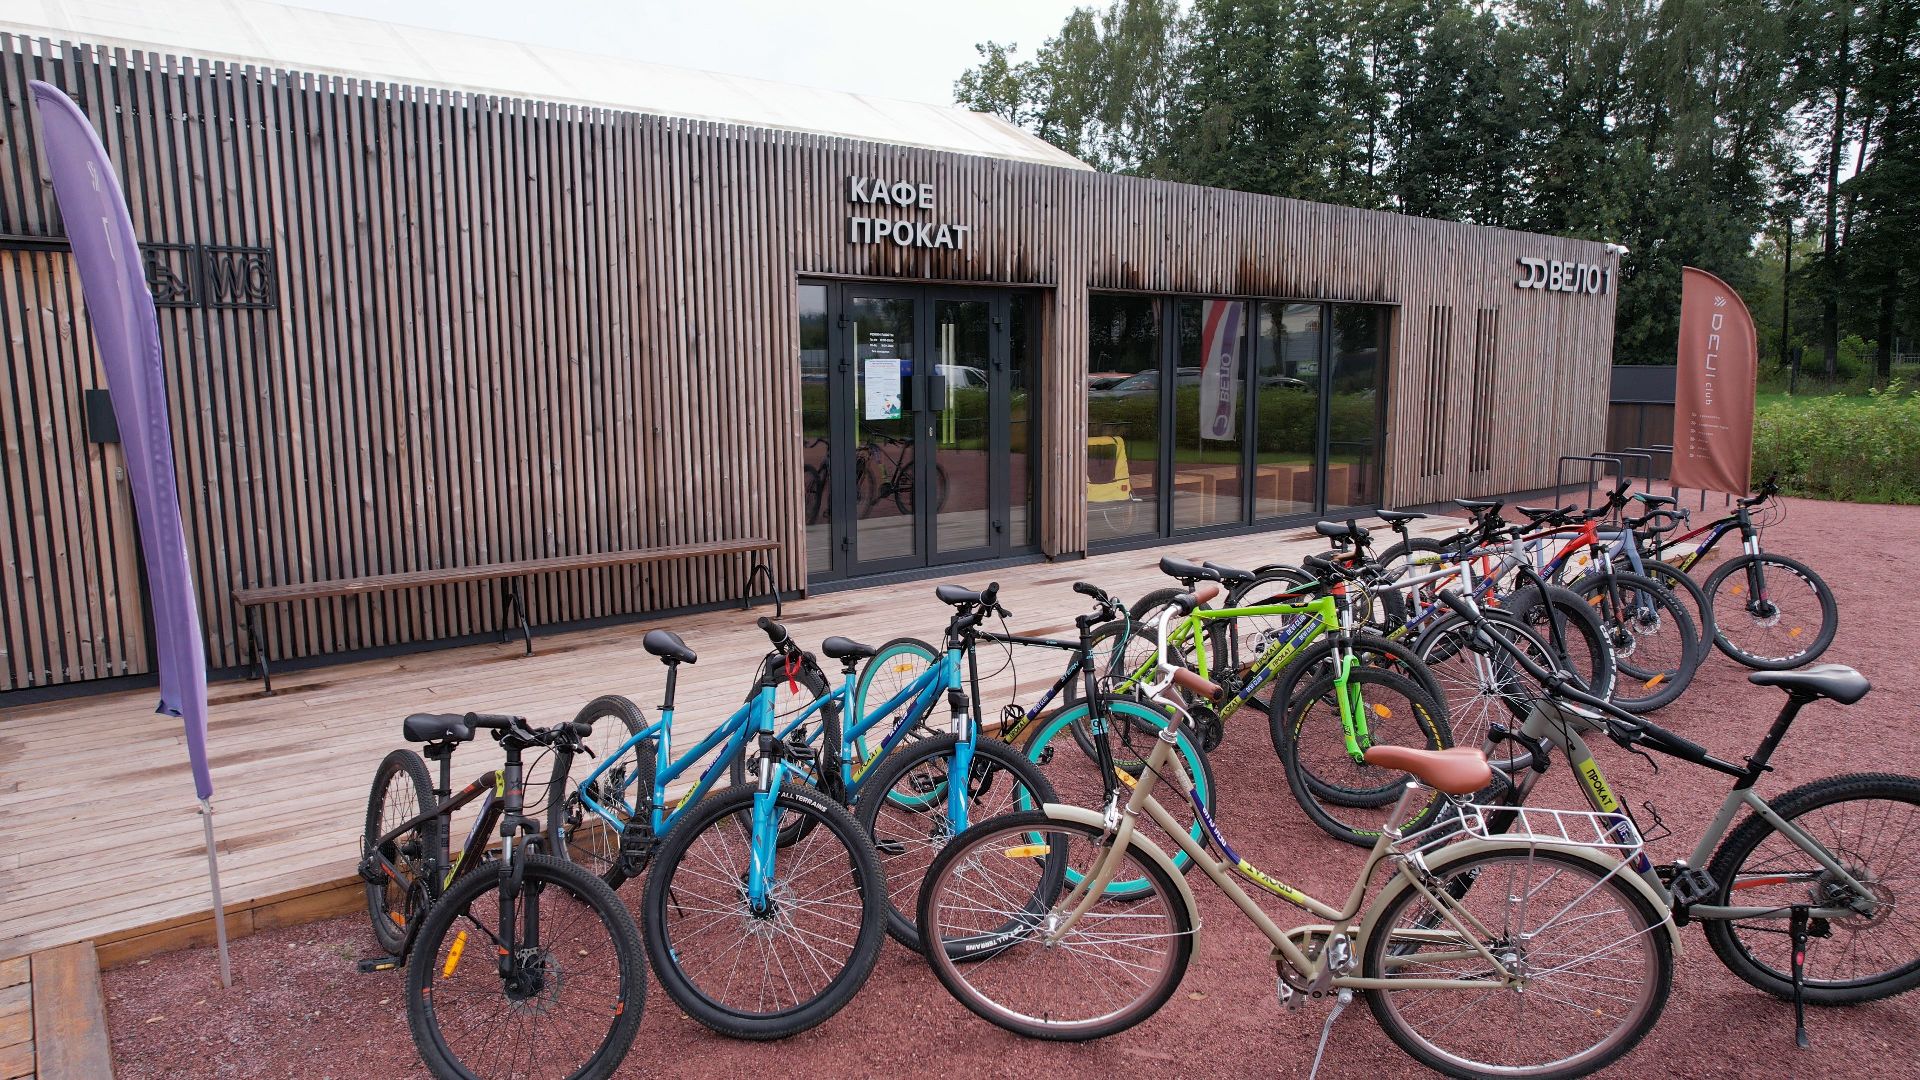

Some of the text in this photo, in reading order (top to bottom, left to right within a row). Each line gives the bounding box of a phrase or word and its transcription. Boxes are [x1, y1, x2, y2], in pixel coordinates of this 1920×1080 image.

[849, 175, 935, 209] КАФЕ
[849, 216, 969, 250] ПРОКАТ
[208, 256, 271, 299] WC
[1549, 261, 1611, 295] ВЕЛО 1
[1704, 382, 1713, 405] club
[1286, 614, 1307, 636] DEVI CLUB
[1256, 644, 1278, 669] ПРОКАТ
[1273, 647, 1292, 667] ПРОКАТ
[1586, 768, 1613, 806] ПРОКАТ
[780, 792, 795, 800] ALL
[795, 794, 828, 813] TERRAINS
[1247, 864, 1293, 894] ПРОКАТ
[965, 940, 998, 951] TERRAINS
[996, 934, 1010, 944] ALL
